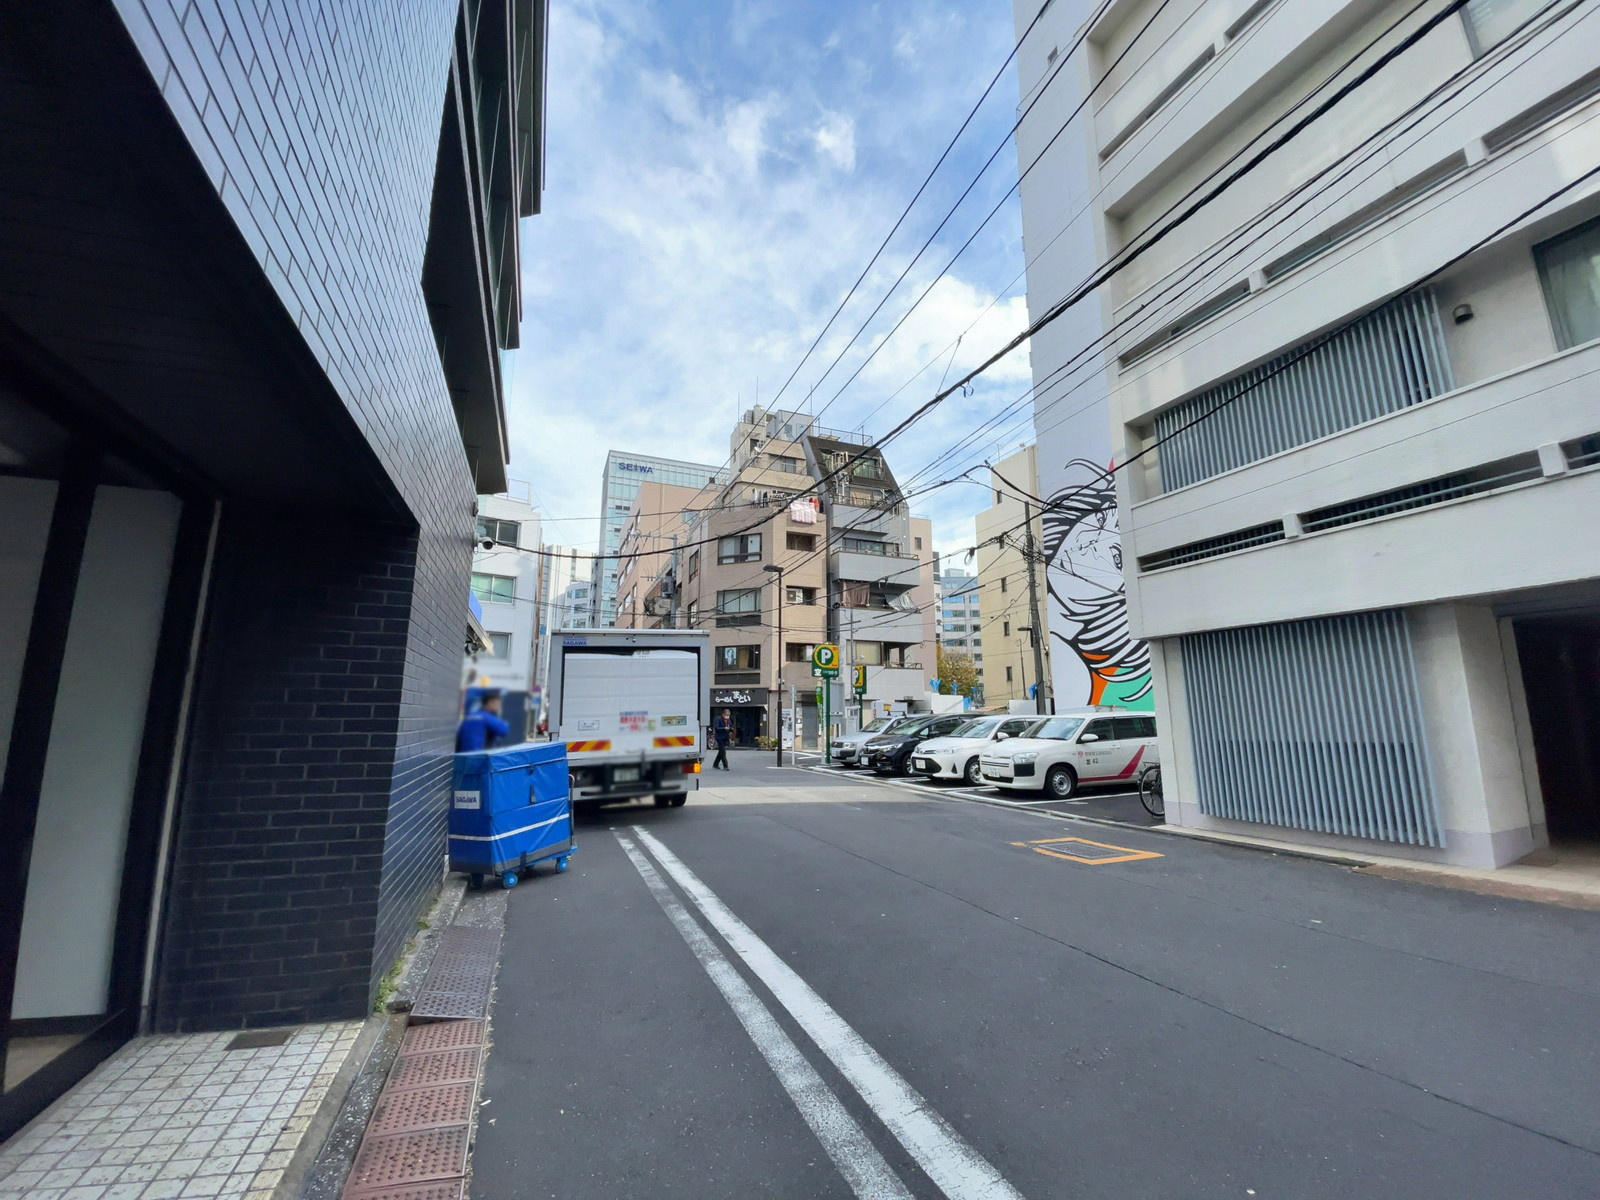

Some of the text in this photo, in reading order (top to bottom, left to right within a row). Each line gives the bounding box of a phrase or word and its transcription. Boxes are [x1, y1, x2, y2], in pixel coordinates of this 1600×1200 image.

[619, 462, 653, 474] SEIWA
[821, 649, 831, 664] P
[456, 796, 477, 804] SAGAWA
